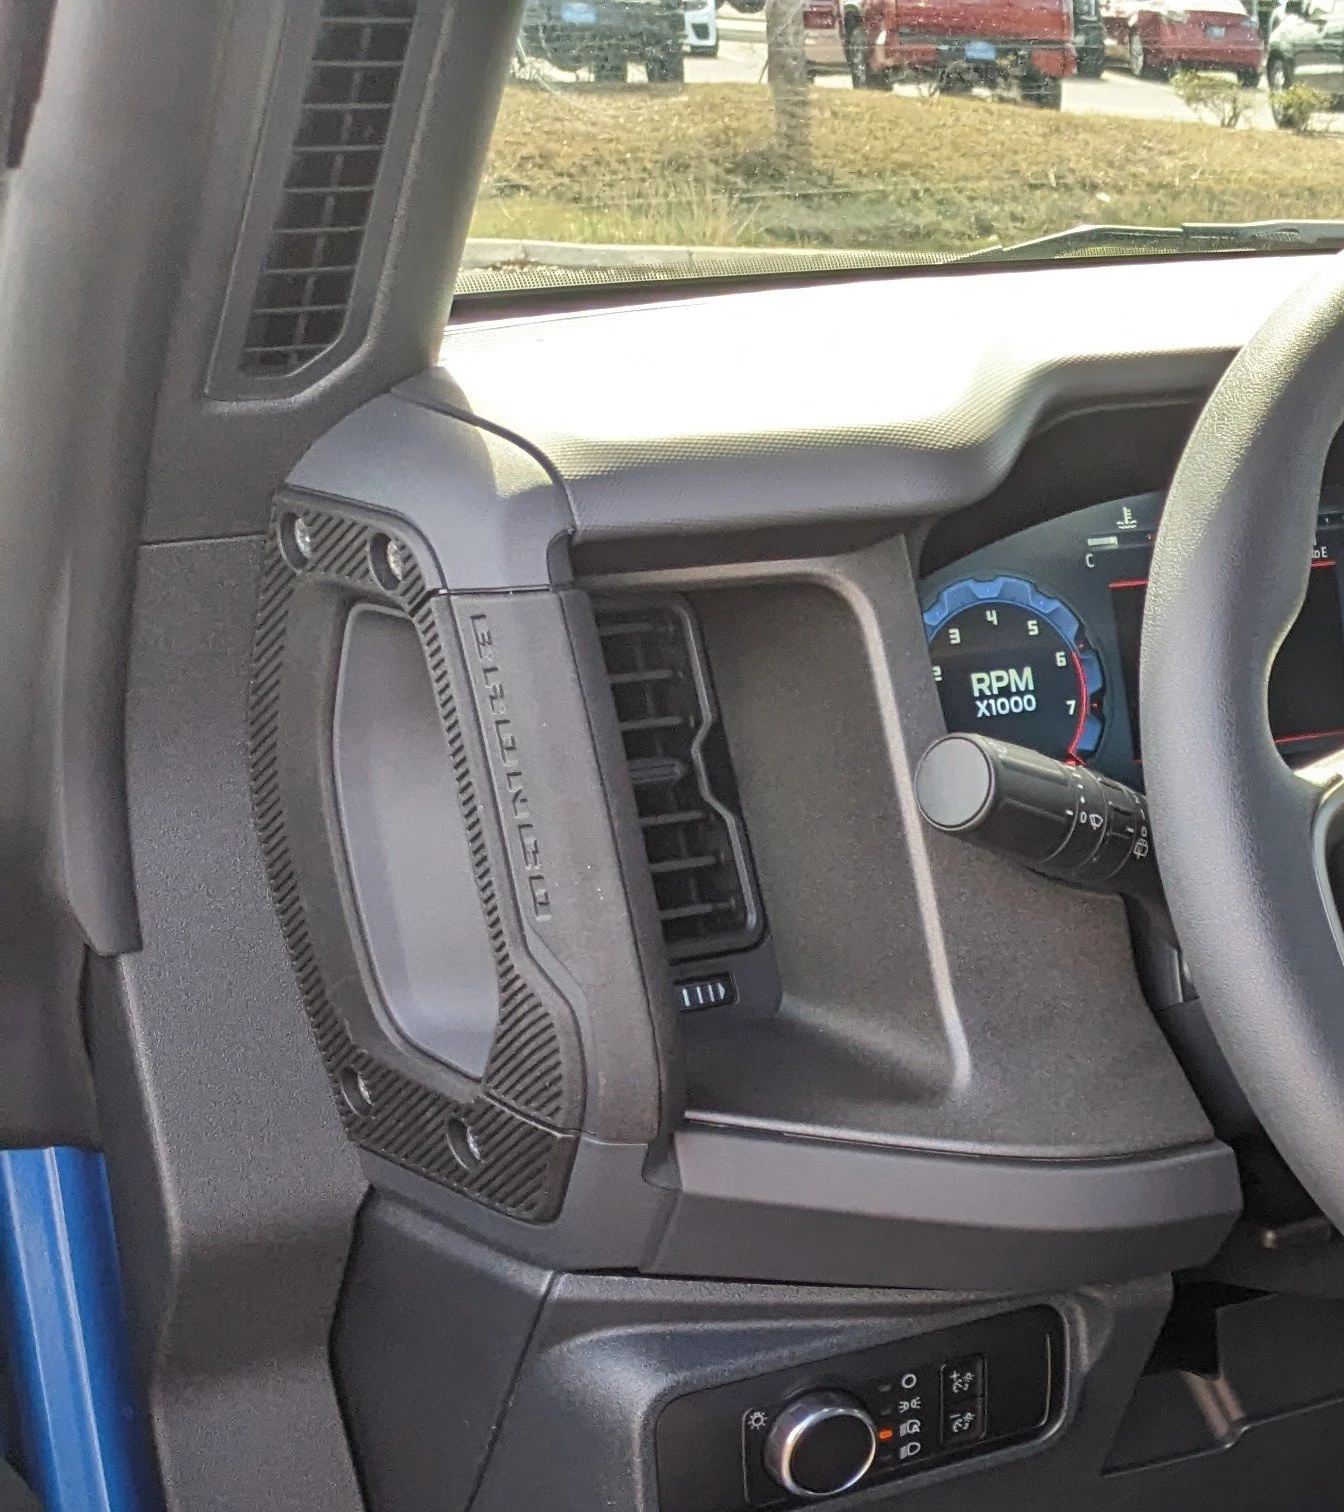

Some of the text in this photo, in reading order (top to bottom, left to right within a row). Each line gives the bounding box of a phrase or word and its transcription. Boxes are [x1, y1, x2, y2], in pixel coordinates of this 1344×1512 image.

[1085, 553, 1095, 568] C
[985, 610, 998, 625] 4
[949, 628, 961, 644] 3
[1027, 620, 1039, 636] 5
[1055, 651, 1067, 667] 6
[970, 666, 1035, 697] RPM
[975, 694, 1037, 718] X1000
[1066, 700, 1076, 715] 7
[471, 613, 552, 921] BRONCO
